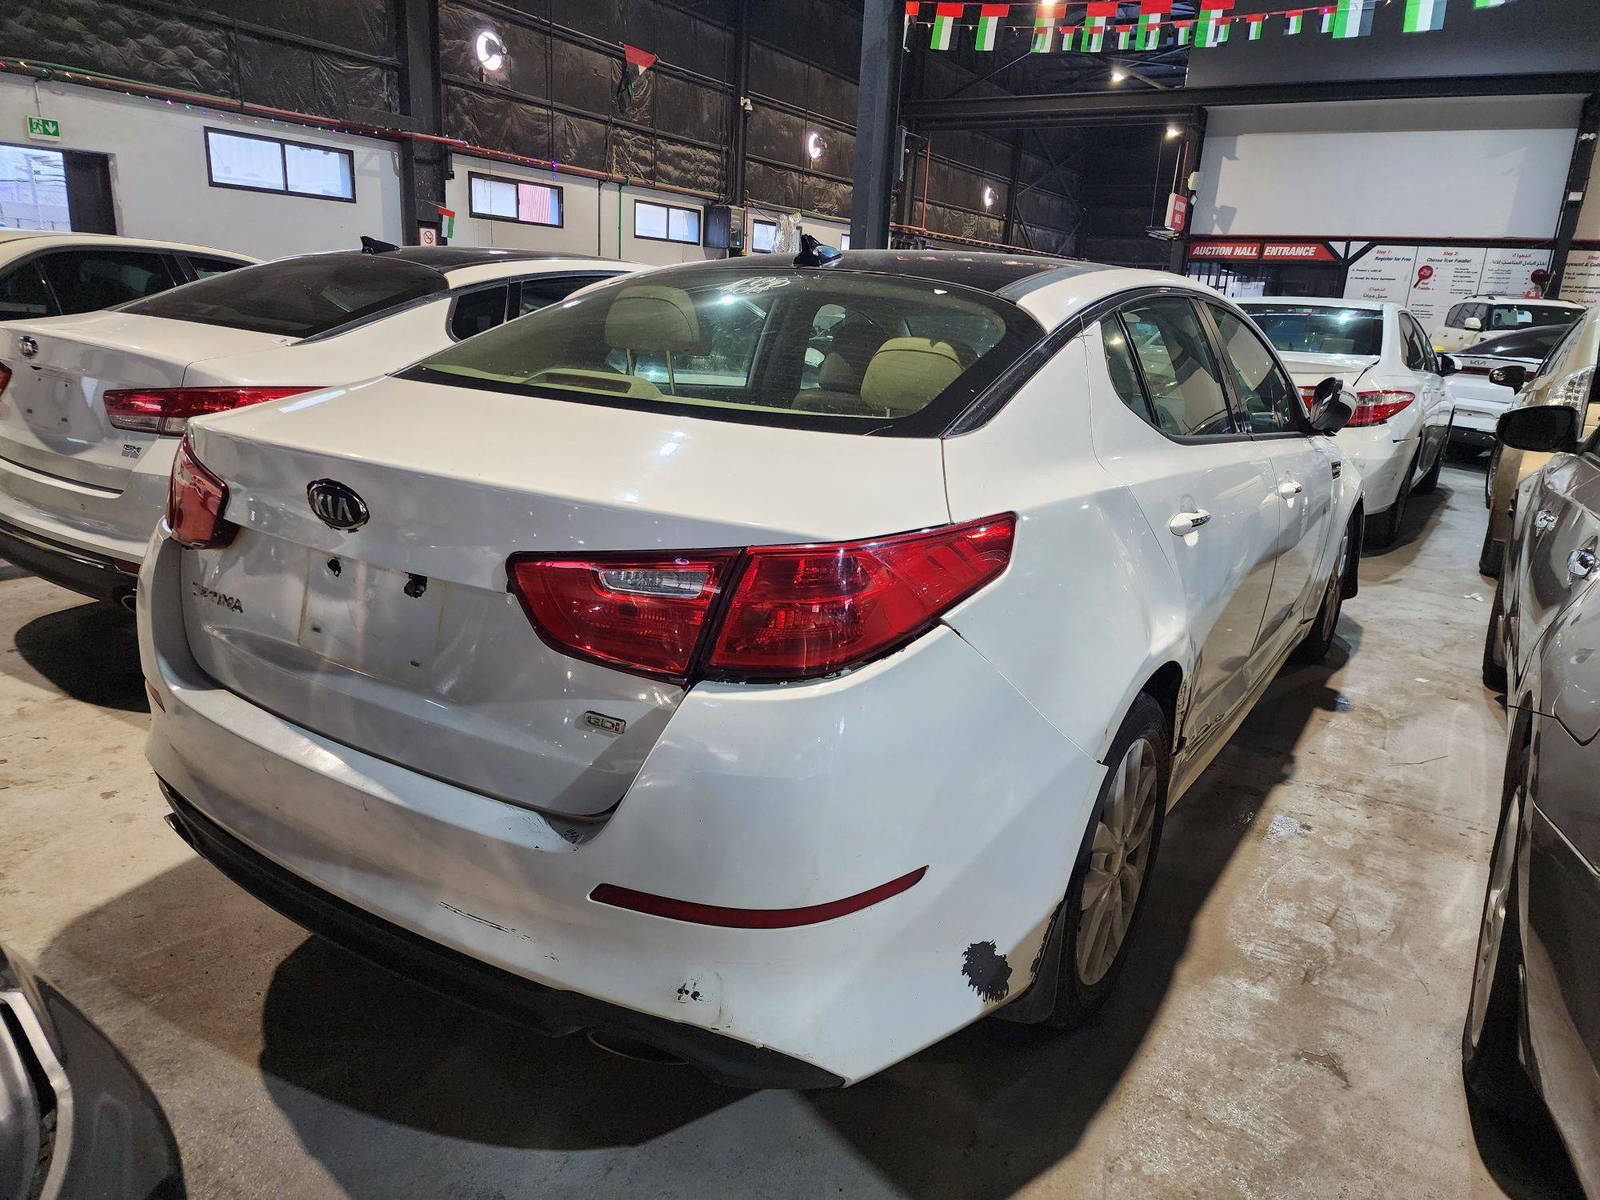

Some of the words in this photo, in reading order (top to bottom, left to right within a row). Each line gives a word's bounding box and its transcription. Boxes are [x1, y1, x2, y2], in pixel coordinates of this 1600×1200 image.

[1193, 246, 1232, 256] AUCTION
[1234, 246, 1258, 256] HALL
[1264, 246, 1317, 257] ENTRANCE
[313, 489, 355, 522] KIA
